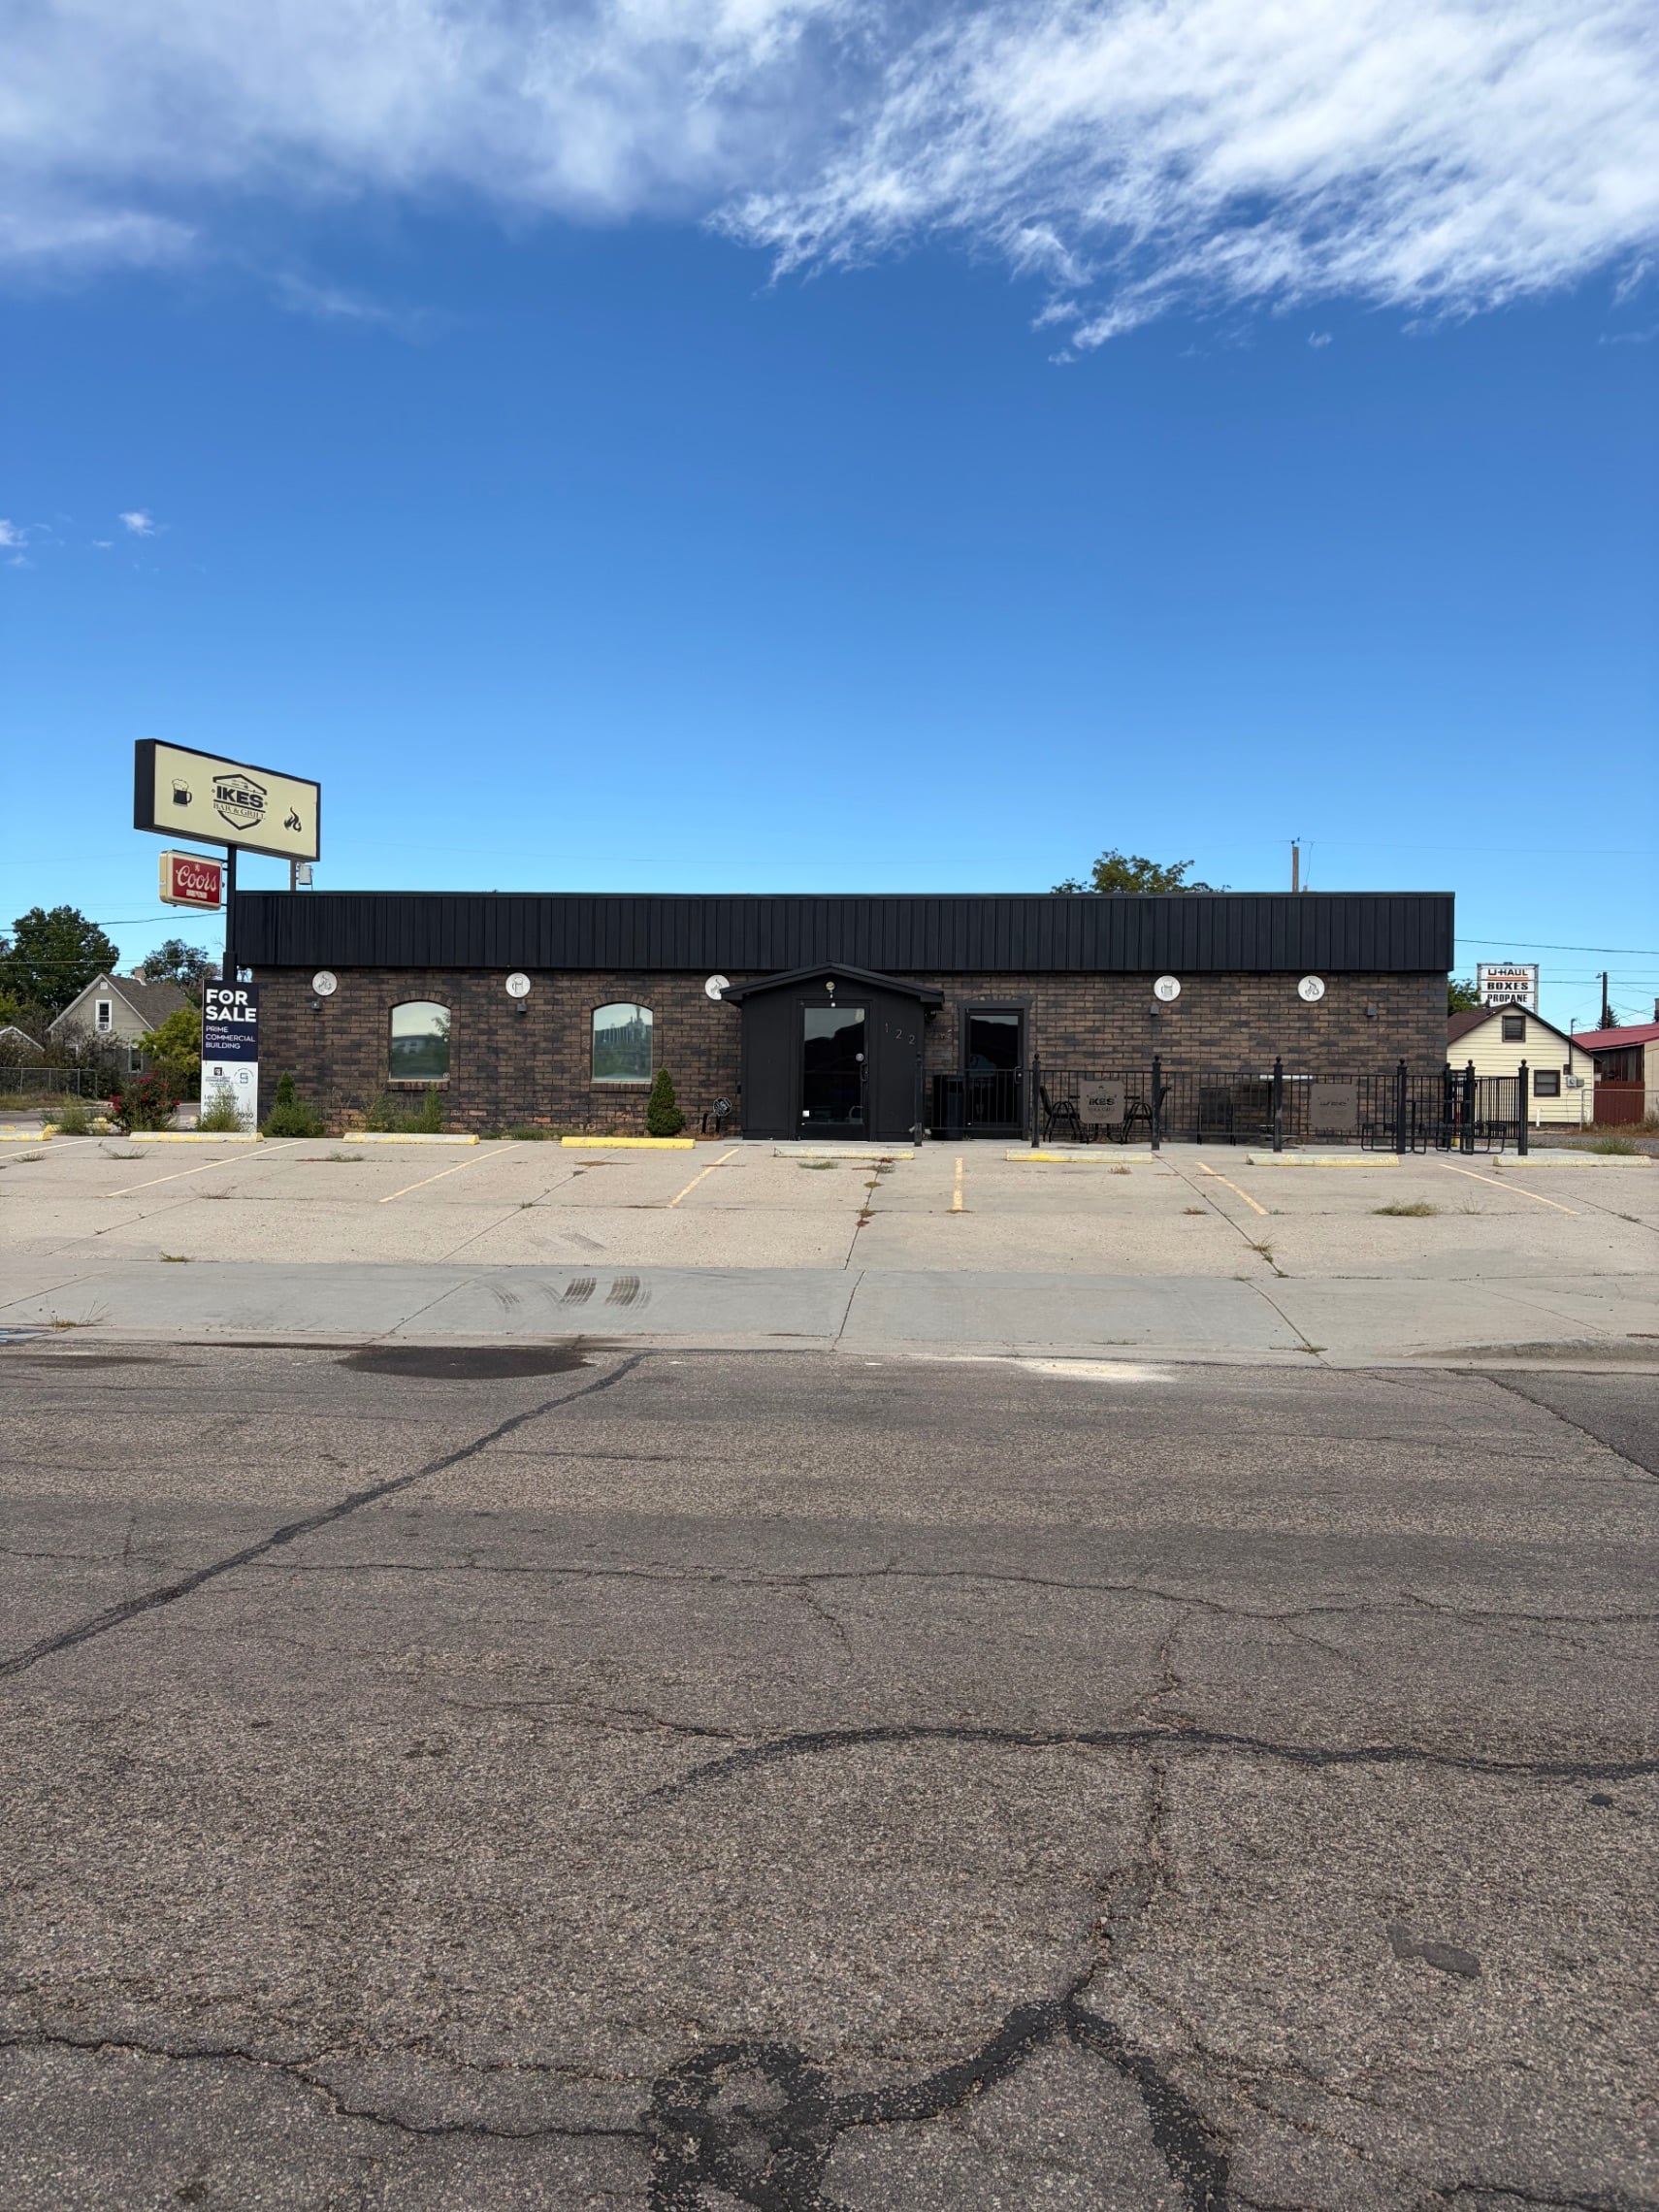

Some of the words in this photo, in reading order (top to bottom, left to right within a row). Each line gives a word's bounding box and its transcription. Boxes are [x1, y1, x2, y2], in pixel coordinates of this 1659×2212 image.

[216, 786, 264, 808] IKES
[213, 801, 232, 812] BAR
[240, 808, 266, 821] GRILL
[176, 865, 216, 893] Coors
[1487, 982, 1529, 991] BOXES
[206, 988, 248, 1006] FOR
[1487, 993, 1528, 1002] PROPANE
[205, 1005, 257, 1023] SALE
[205, 1033, 255, 1042] COMMERCIAL
[205, 1041, 242, 1050] BUILDING
